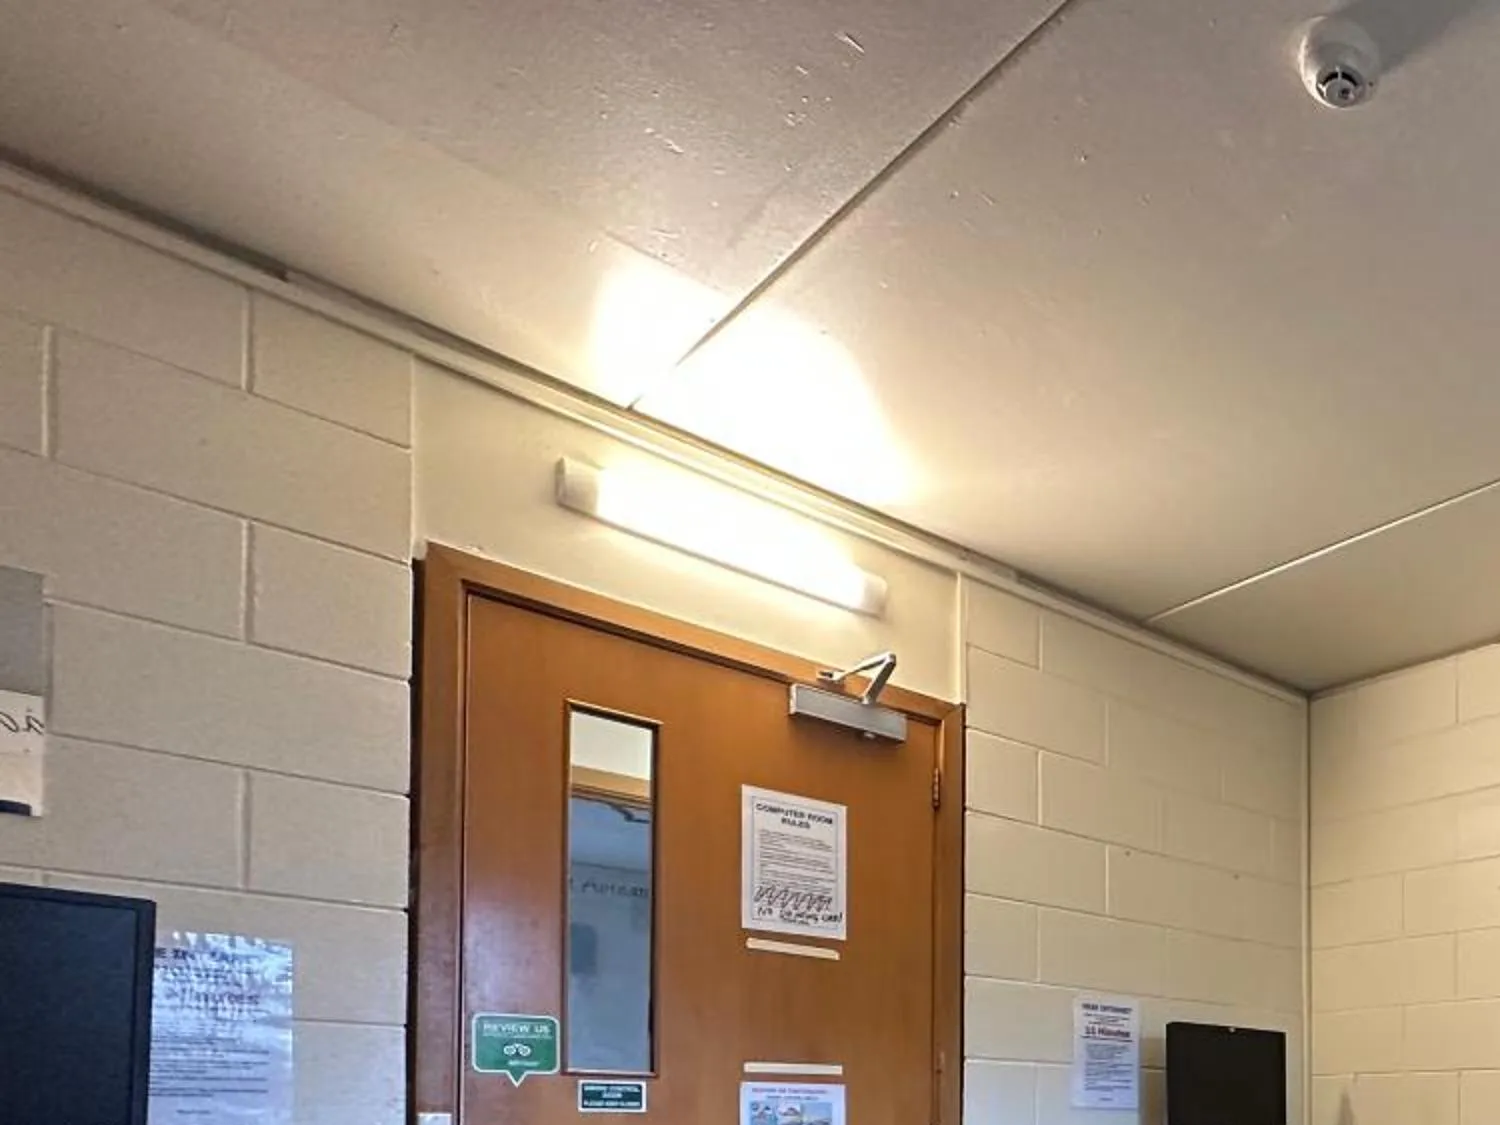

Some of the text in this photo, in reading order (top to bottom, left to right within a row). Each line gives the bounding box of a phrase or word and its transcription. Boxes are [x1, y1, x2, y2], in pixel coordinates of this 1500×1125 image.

[756, 803, 805, 818] COMPUTER
[482, 1022, 550, 1033] REVIEW US
